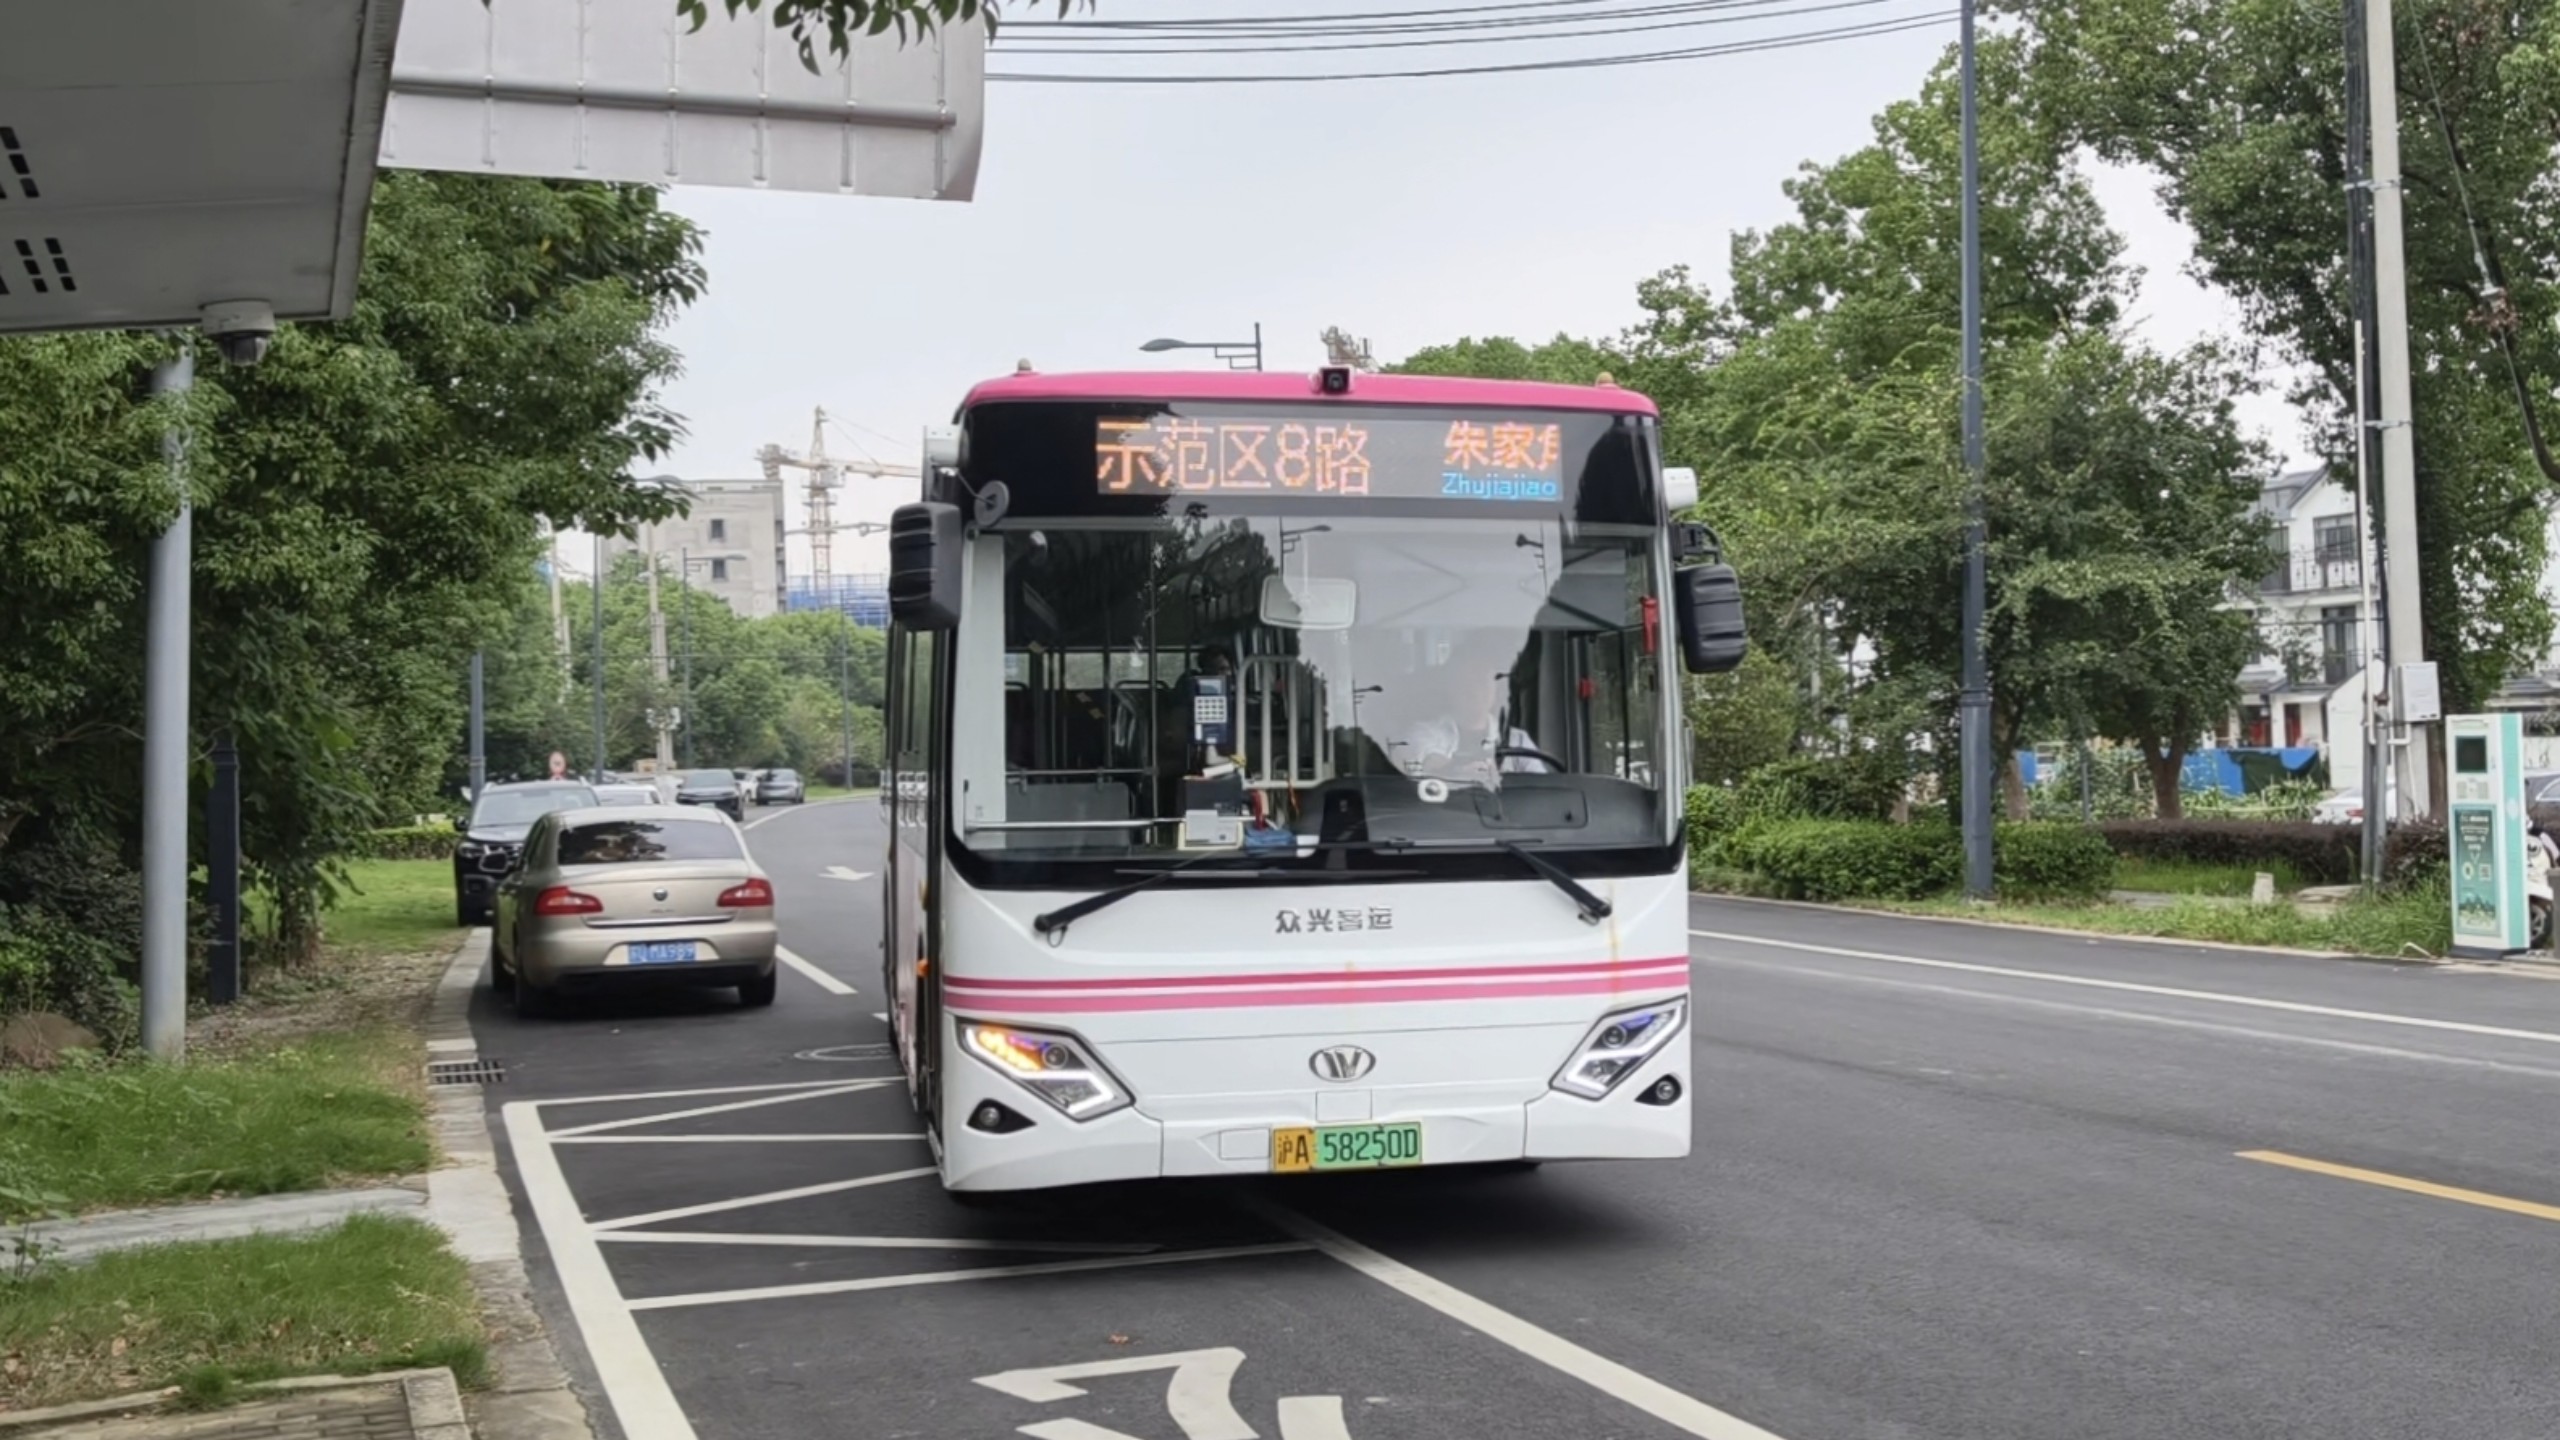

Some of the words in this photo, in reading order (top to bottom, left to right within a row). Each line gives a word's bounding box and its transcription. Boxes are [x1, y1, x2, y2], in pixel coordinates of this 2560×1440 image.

[1096, 421, 1371, 495] 示范区8路
[1441, 471, 1558, 499] Zhujiajiao
